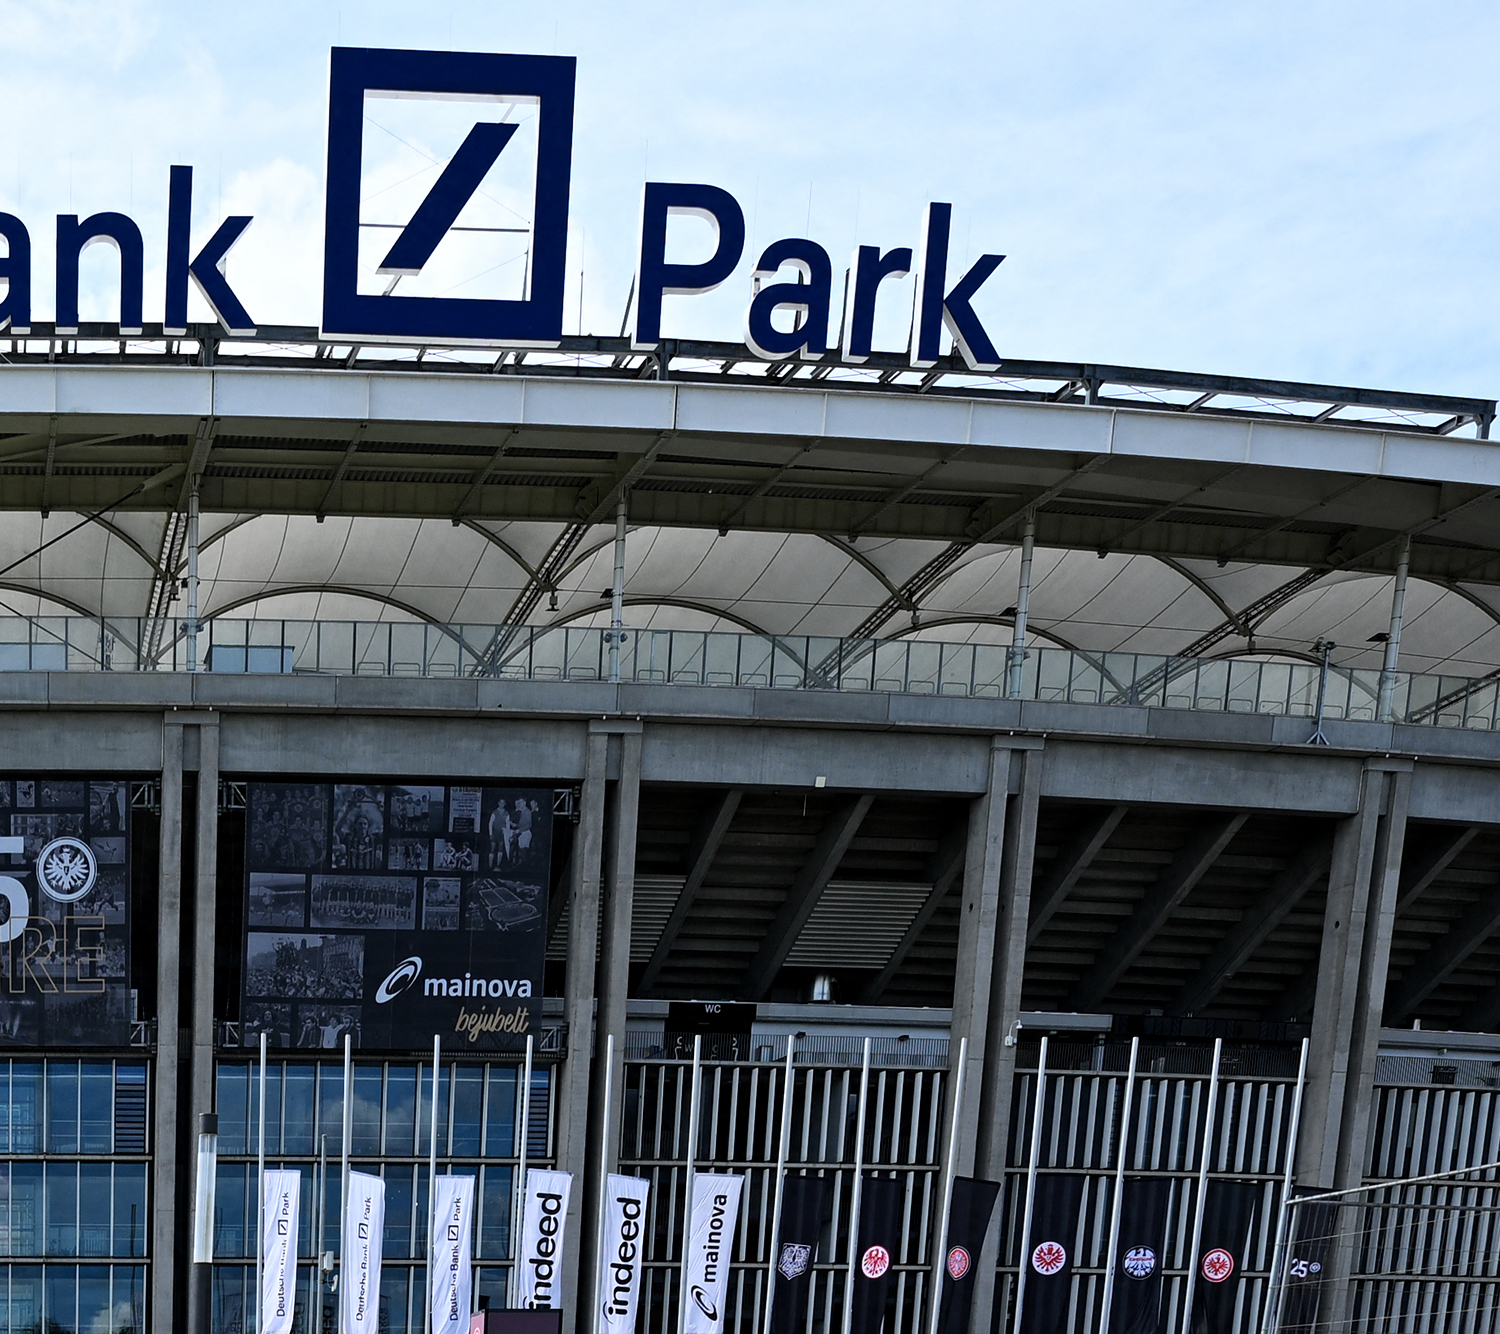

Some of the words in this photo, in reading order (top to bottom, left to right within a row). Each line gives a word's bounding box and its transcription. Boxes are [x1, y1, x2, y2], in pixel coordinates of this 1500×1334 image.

[634, 181, 1004, 372] Park
[423, 972, 532, 998] mainova
[705, 1004, 721, 1013] WC
[454, 1005, 530, 1042] bejubelt
[281, 1191, 289, 1216] Park
[363, 1196, 372, 1221] Park
[453, 1197, 462, 1221] Park
[523, 1192, 562, 1309] indeed
[703, 1194, 728, 1283] mainova
[451, 1244, 459, 1271] Bank
[602, 1197, 642, 1325] indeed
